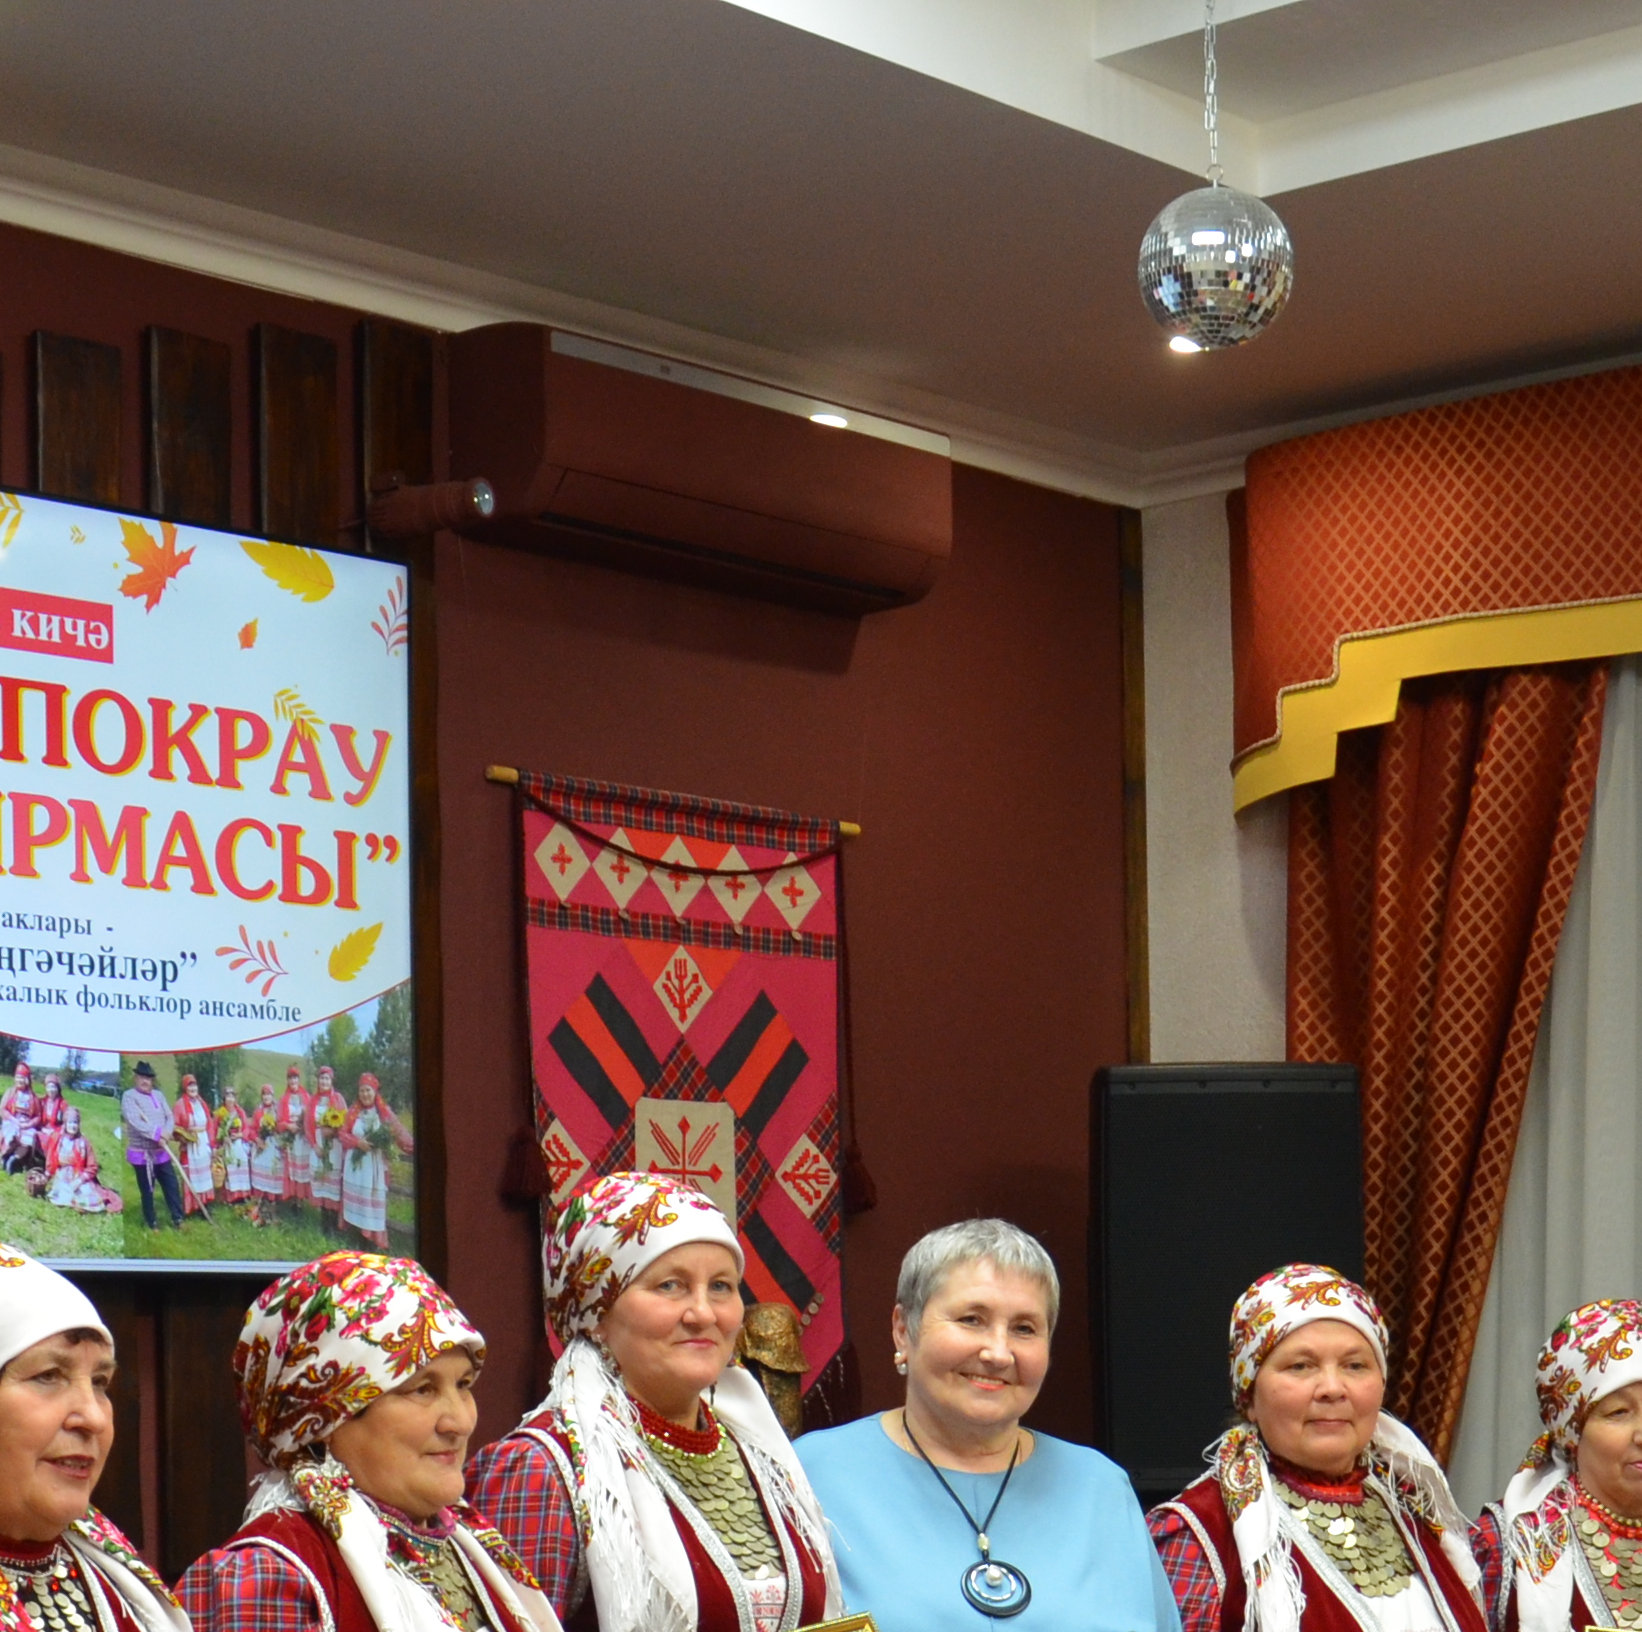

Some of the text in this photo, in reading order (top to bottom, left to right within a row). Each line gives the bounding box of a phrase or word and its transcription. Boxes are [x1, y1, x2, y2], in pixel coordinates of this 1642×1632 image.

[11, 609, 110, 652] кичә
[74, 981, 192, 1019] фольклор
[198, 998, 302, 1024] ансамбле
